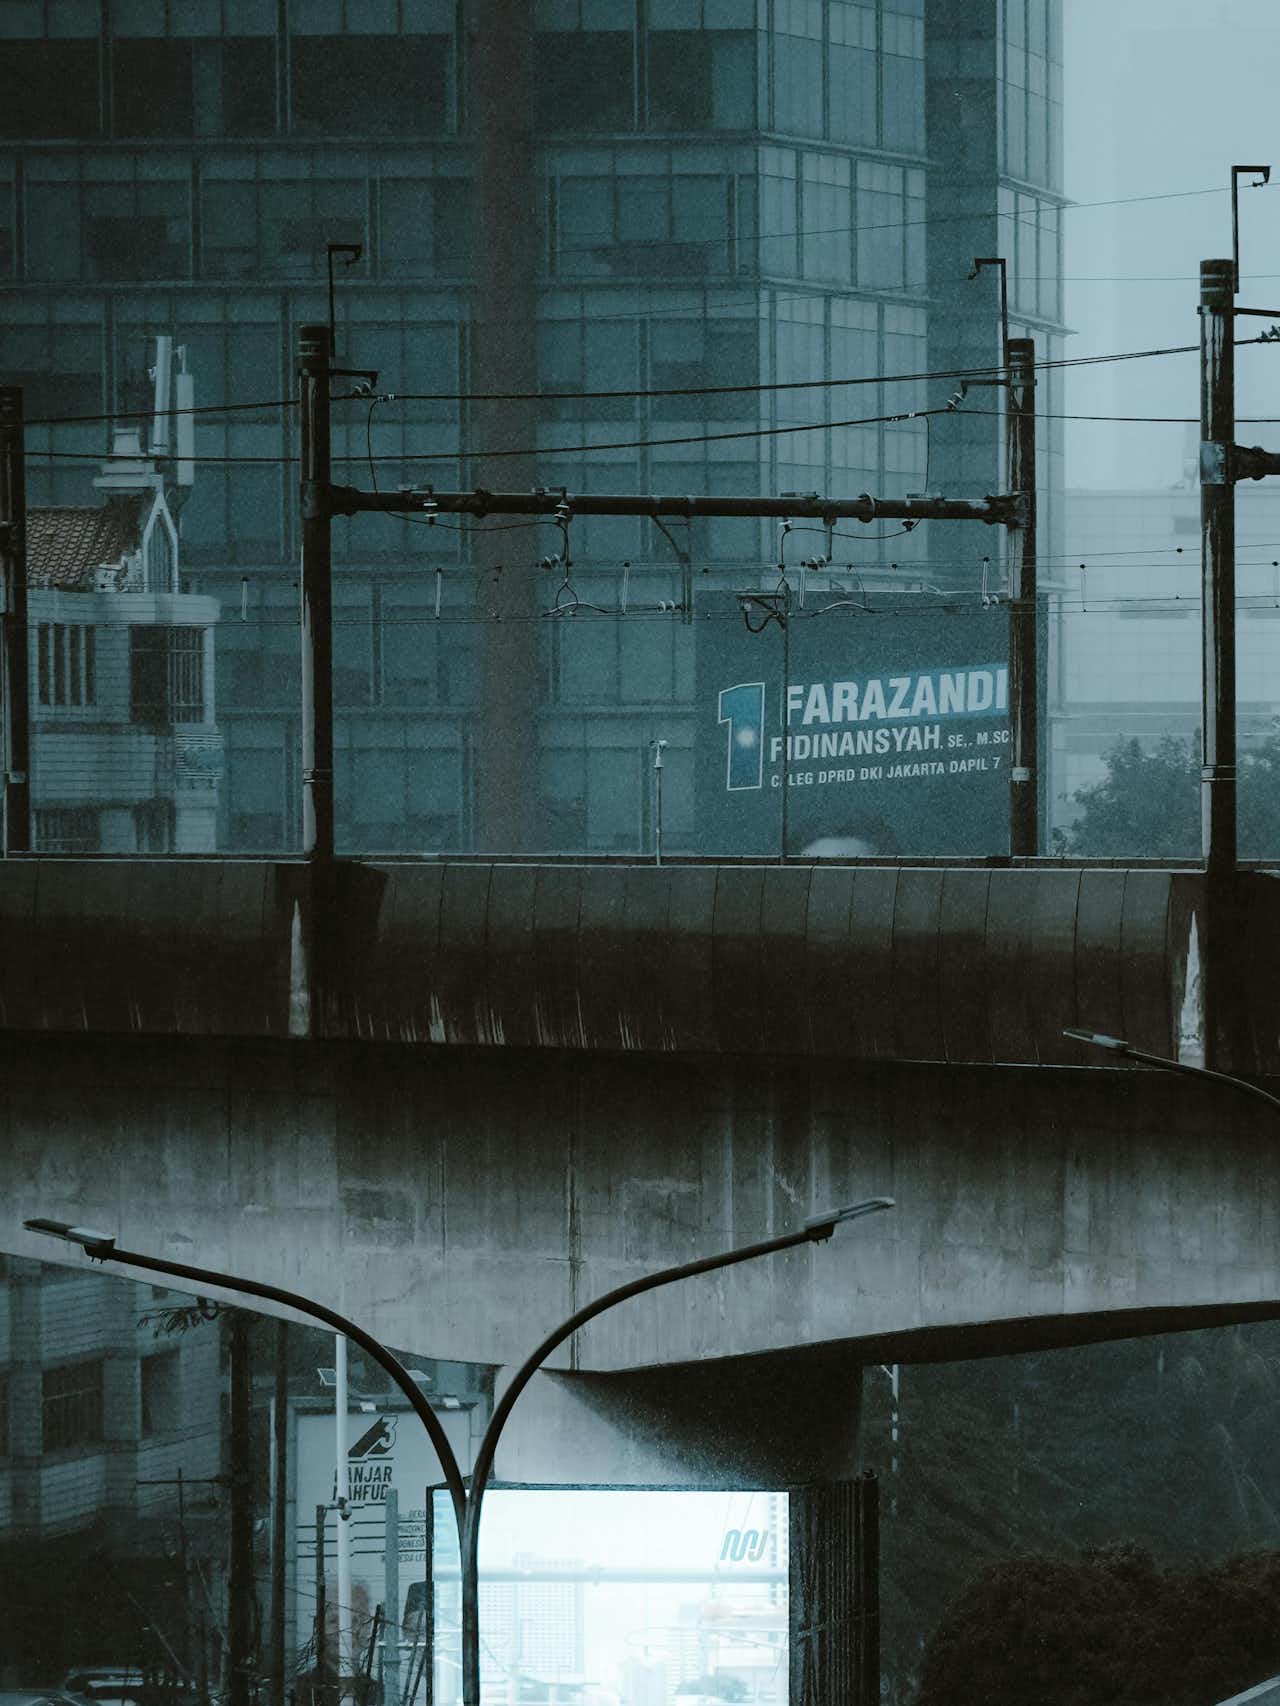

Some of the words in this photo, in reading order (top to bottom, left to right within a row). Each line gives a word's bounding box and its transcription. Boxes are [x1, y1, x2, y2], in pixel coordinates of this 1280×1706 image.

[779, 669, 1008, 727] FARAZANDI
[718, 682, 766, 791] 1
[770, 771, 814, 788] CLEG
[818, 768, 856, 784] DPRD
[860, 766, 883, 781] DKI
[886, 762, 945, 779] JAKARTA
[949, 758, 989, 774] DAPIL
[992, 756, 1001, 769] 7
